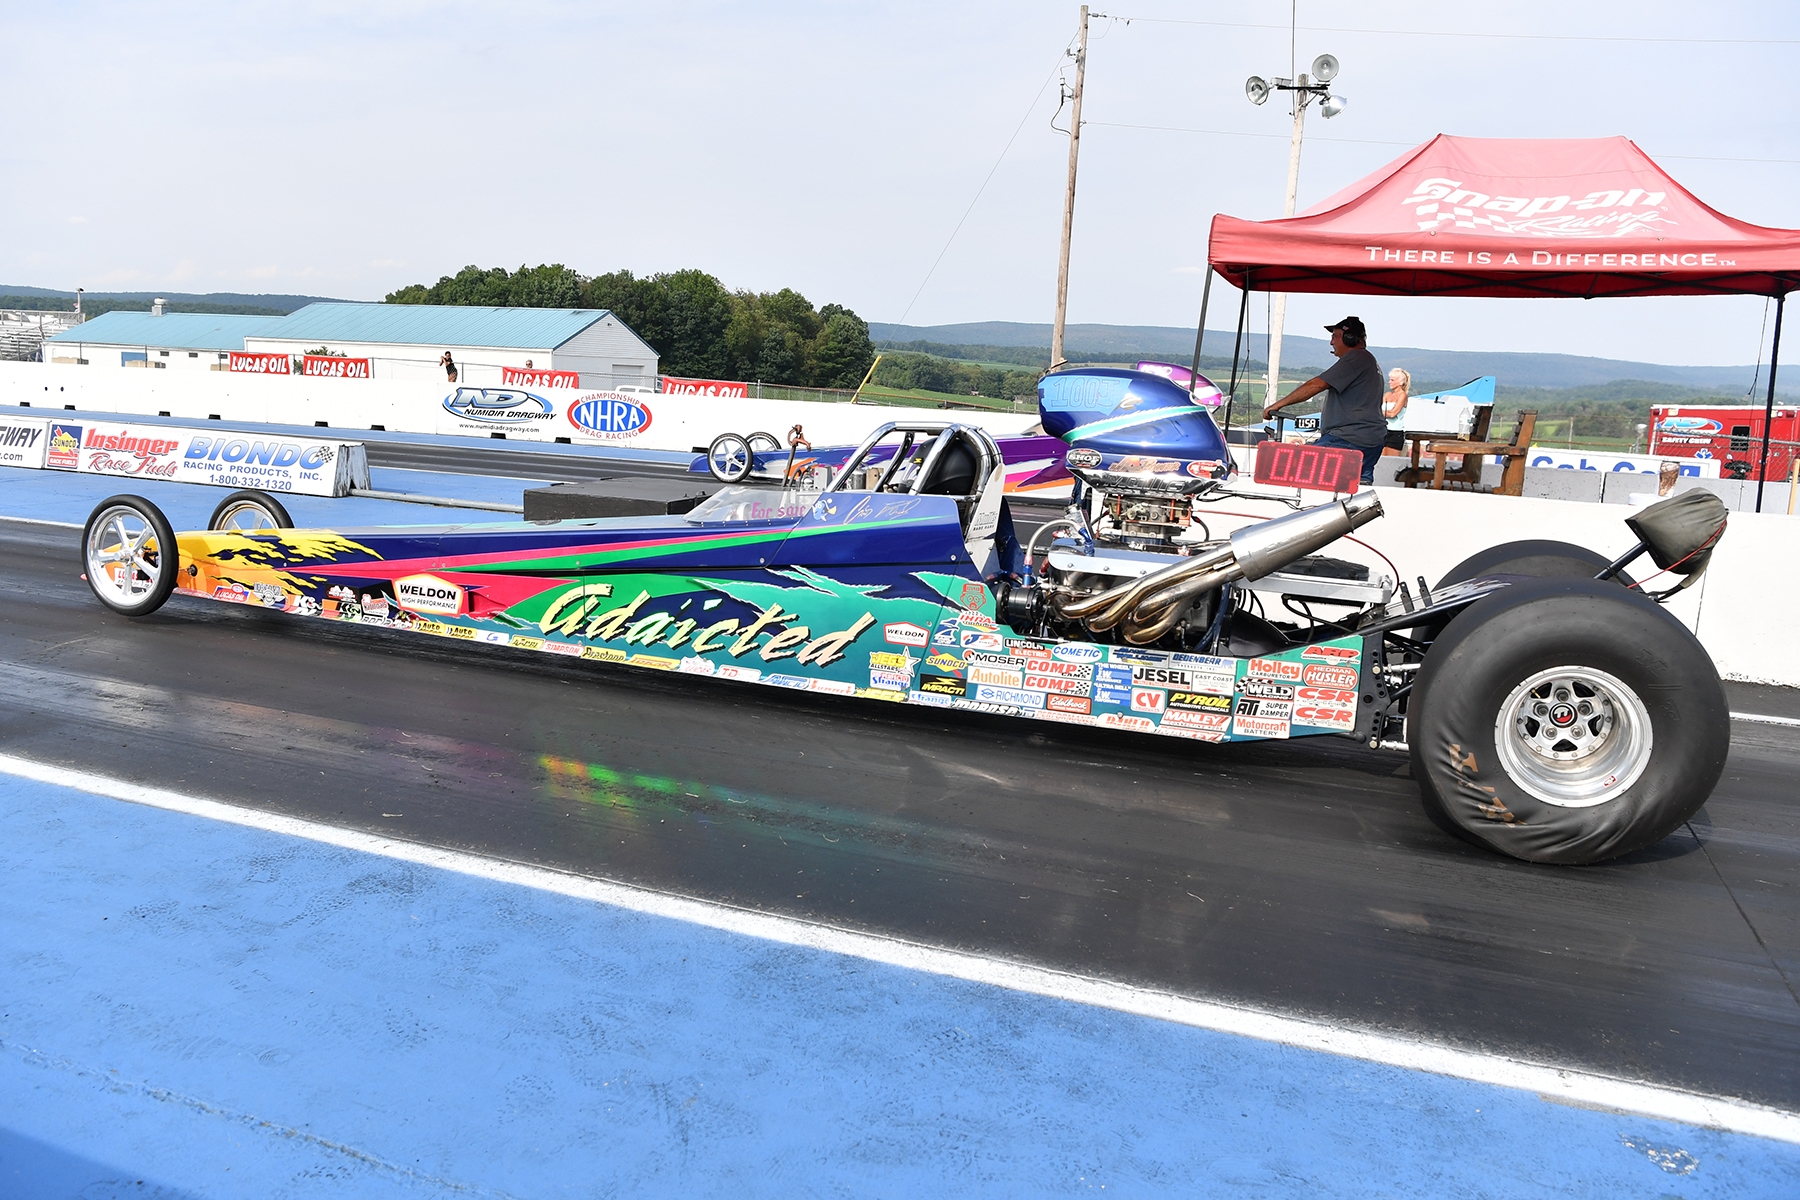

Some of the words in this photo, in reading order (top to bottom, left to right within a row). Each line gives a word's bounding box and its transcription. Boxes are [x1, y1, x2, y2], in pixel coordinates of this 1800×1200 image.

[1400, 178, 1667, 220] Snap-on
[1503, 252, 1520, 265] A
[231, 356, 267, 373] LUCAS
[268, 357, 289, 374] OIL
[306, 360, 345, 378] LUCAS
[347, 362, 368, 379] OIL
[503, 371, 551, 388] LUCAS
[552, 374, 577, 389] OIL
[580, 392, 641, 406] CHAMPIONSHIP
[464, 408, 504, 418] NUMIDIA
[506, 411, 558, 421] DRAGWAY
[580, 401, 641, 431] NHRA
[459, 423, 541, 433] www.numidiadragway.com
[579, 428, 604, 440] DRAG
[606, 429, 639, 440] RACING
[53, 438, 78, 450] SUNOCO
[85, 428, 179, 457] Insinger
[184, 436, 328, 470] BIONDO
[49, 458, 63, 466] RACE
[62, 459, 78, 468] FUELS
[89, 452, 132, 472] Race
[1269, 448, 1344, 487] 0.00
[183, 461, 223, 472] RACING
[230, 466, 293, 480] PRODUCTS,
[299, 472, 324, 482] INC.
[209, 474, 293, 491] 1-800-332-1320
[751, 501, 773, 519] For
[217, 591, 235, 599] LUCAS
[400, 584, 457, 602] WELDON
[417, 598, 457, 610] PERFORMANCE
[422, 622, 441, 631] Auto
[454, 627, 473, 635] Auto
[887, 629, 925, 638] WELDON
[545, 643, 580, 655] SIMPSON
[1005, 639, 1045, 651] LINCOLN
[1014, 650, 1048, 659] ELECTRIC
[1053, 645, 1101, 659] COMETIC
[1303, 646, 1359, 659] ARP
[927, 657, 966, 669] SUNOCO
[975, 655, 1025, 667] MOSER
[1172, 653, 1222, 665] DEDENBEAR
[1026, 659, 1078, 675] COMP
[1250, 660, 1301, 680] Holley
[1313, 666, 1352, 675] HEDMAN
[970, 668, 1020, 687] Autolite
[1061, 671, 1087, 679] CAMS
[1134, 668, 1190, 686] JESEL
[1251, 671, 1292, 680] CARBURETOR
[1306, 671, 1356, 686] HUSLER
[872, 676, 909, 688] Strange
[1025, 675, 1076, 691] COMP
[1059, 689, 1088, 697] LIFTERS
[1249, 685, 1292, 696] WELD
[1297, 687, 1355, 704] CSR
[995, 691, 1042, 706] RICHMOND
[1049, 697, 1088, 710] Edelbrock
[1136, 693, 1161, 708] CV
[1170, 692, 1231, 709] PYROIL
[1169, 702, 1201, 710] AUTOMOTIVE
[1201, 705, 1229, 713] CHEMICALS
[1264, 702, 1289, 710] SUPER
[1166, 709, 1222, 726] MANLEY
[1259, 708, 1290, 718] DAMPER
[1295, 706, 1353, 723] CSR
[1236, 718, 1287, 733] Motorcraft
[1243, 728, 1279, 737] BATTERY
